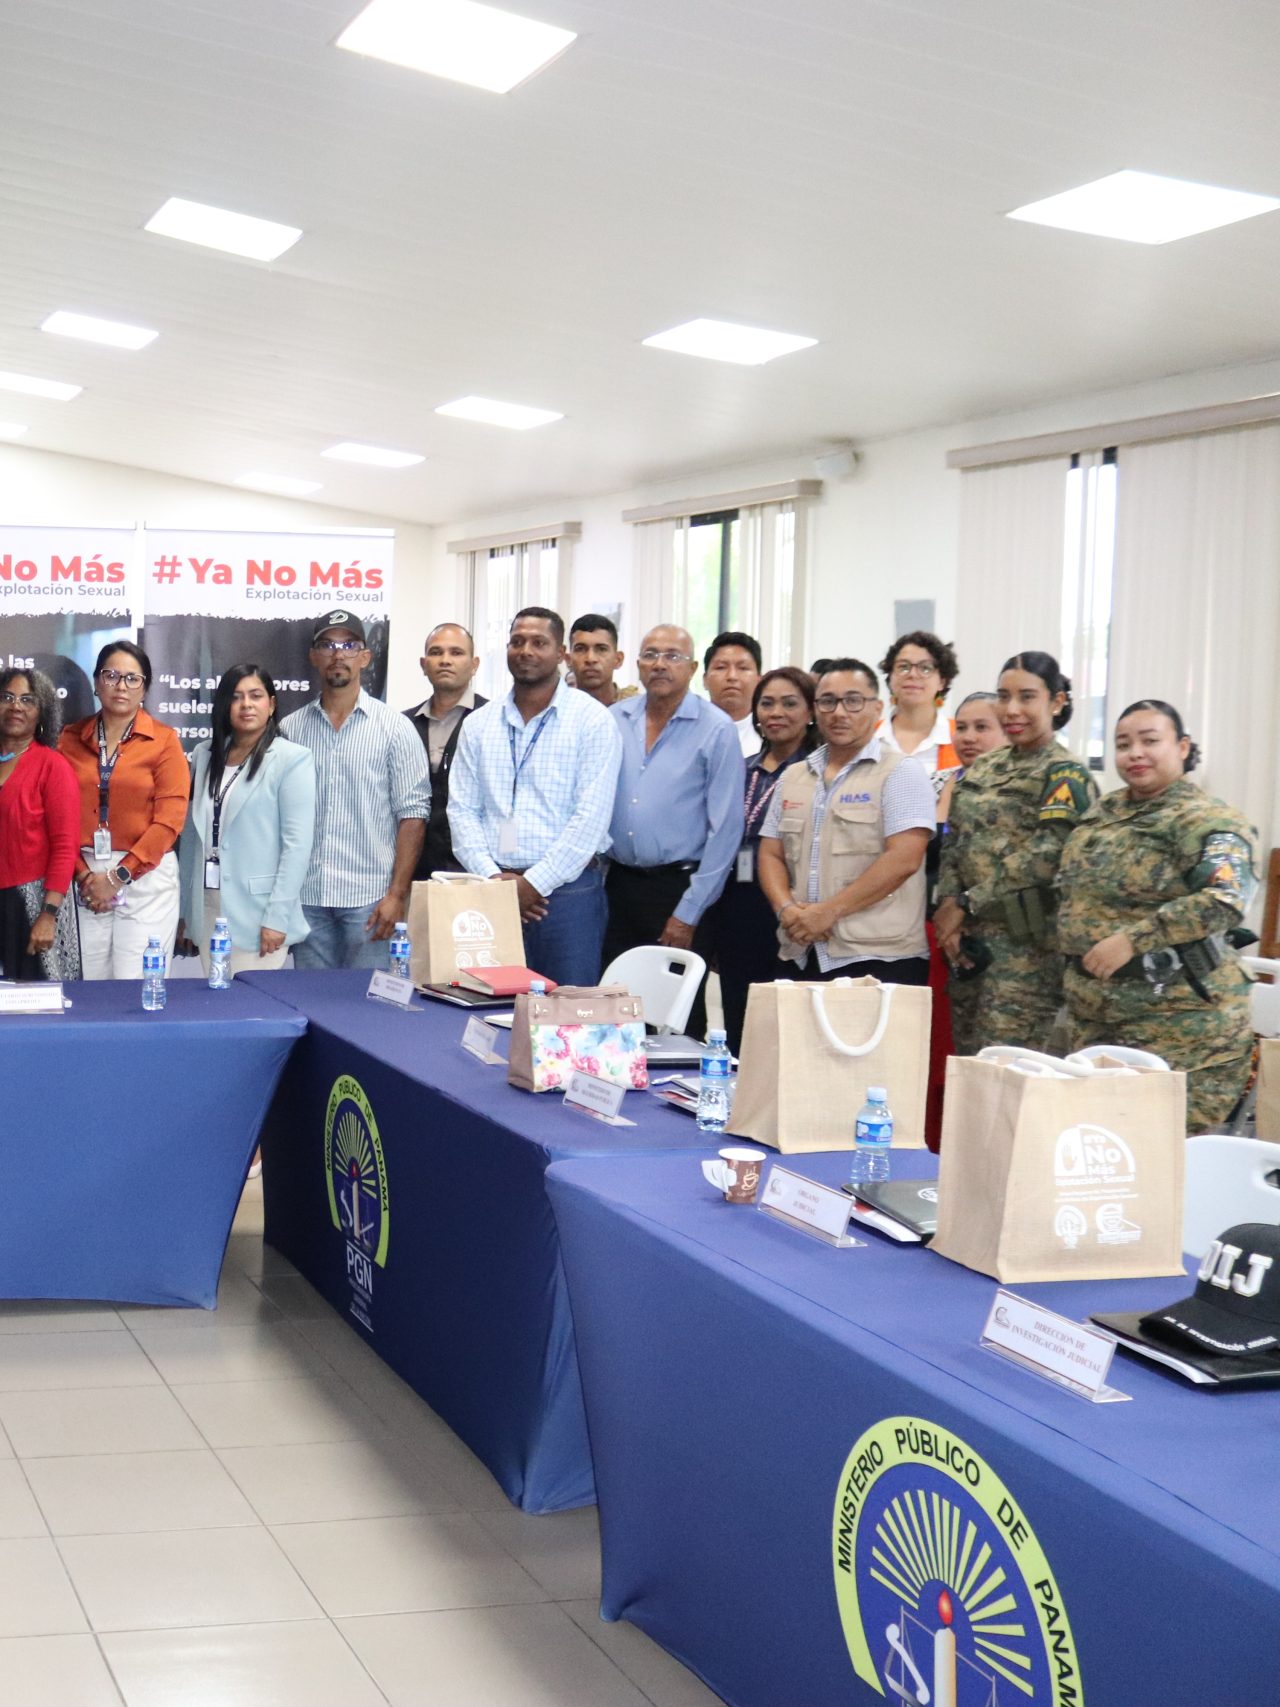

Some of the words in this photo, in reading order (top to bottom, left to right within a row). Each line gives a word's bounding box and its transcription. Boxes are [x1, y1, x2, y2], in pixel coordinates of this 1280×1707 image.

[50, 554, 126, 584] Más
[152, 555, 233, 585] #Ya
[246, 559, 297, 587] No
[309, 560, 384, 589] Más
[77, 584, 126, 597] Sexual
[245, 587, 332, 602] Explotación
[336, 589, 384, 602] Sexual
[8, 654, 35, 669] las
[839, 793, 871, 803] HIAS
[346, 1244, 373, 1295] PGN
[1075, 1342, 1088, 1352] DE
[1067, 1350, 1102, 1374] JUDICIAL
[837, 1440, 885, 1574] MINISTERIO
[894, 1421, 981, 1487] PÚBLICO
[996, 1497, 1029, 1551] DE
